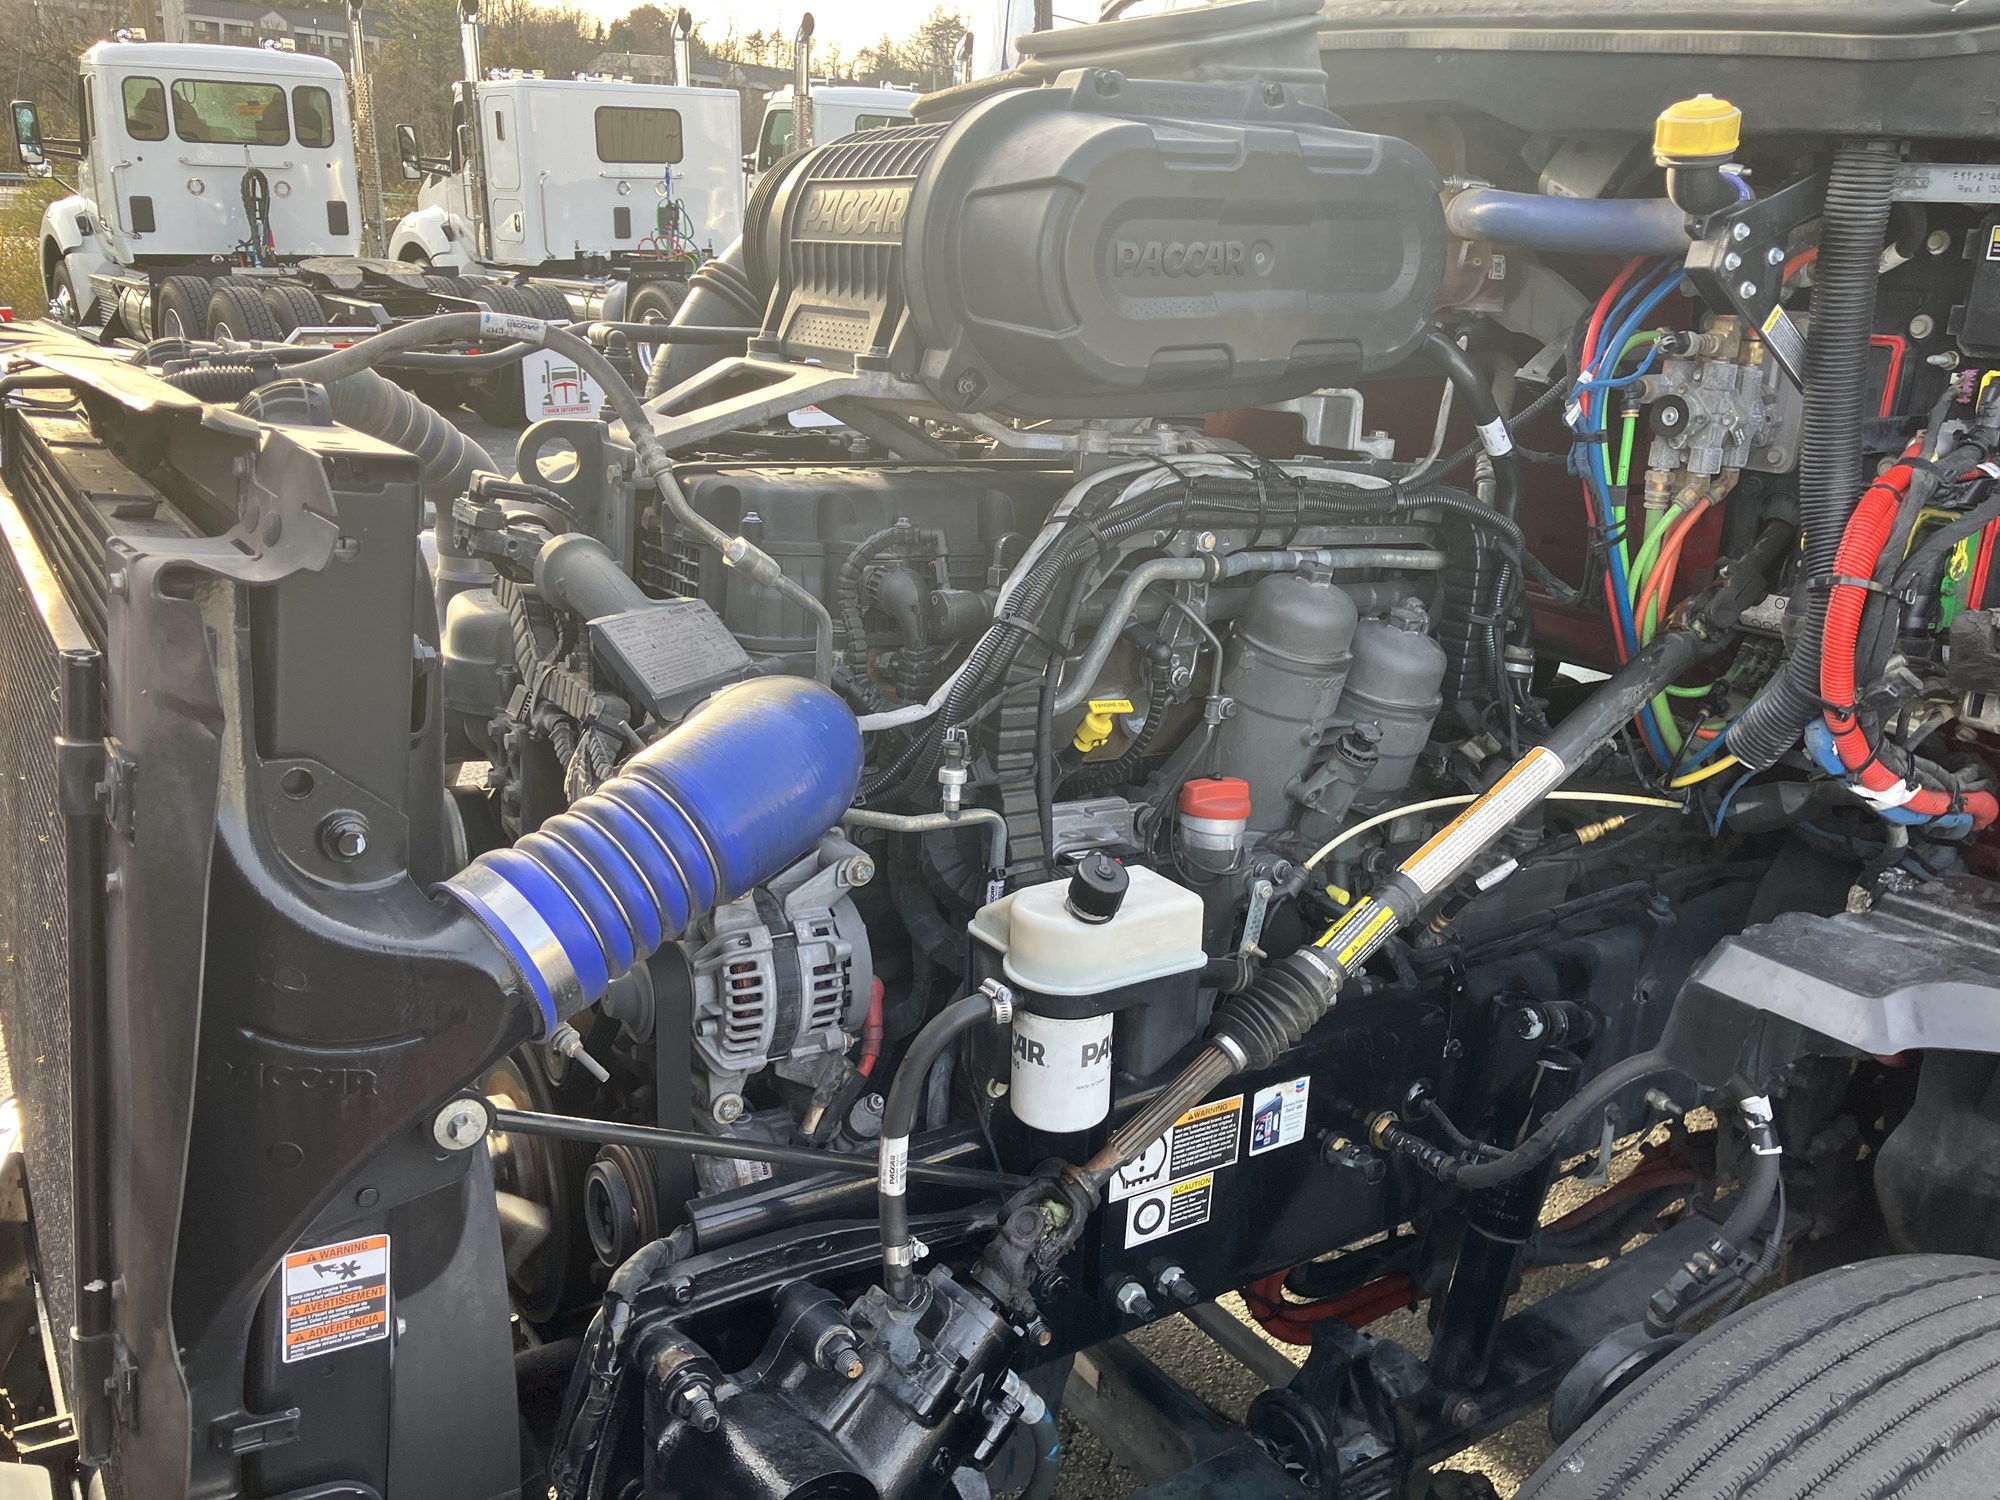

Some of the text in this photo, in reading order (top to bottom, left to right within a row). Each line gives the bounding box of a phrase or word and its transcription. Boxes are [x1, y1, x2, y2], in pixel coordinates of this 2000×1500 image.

[800, 187, 912, 236] PACCAR
[1114, 241, 1246, 278] PACCAR
[1462, 793, 1492, 821] WARNING
[1194, 1103, 1228, 1119] WARNING
[1179, 1177, 1210, 1193] CAUTION
[320, 1241, 368, 1259] WARNING
[304, 1286, 384, 1314] AVERTISSEMENT
[308, 1314, 379, 1338] ADVERTENCIA
